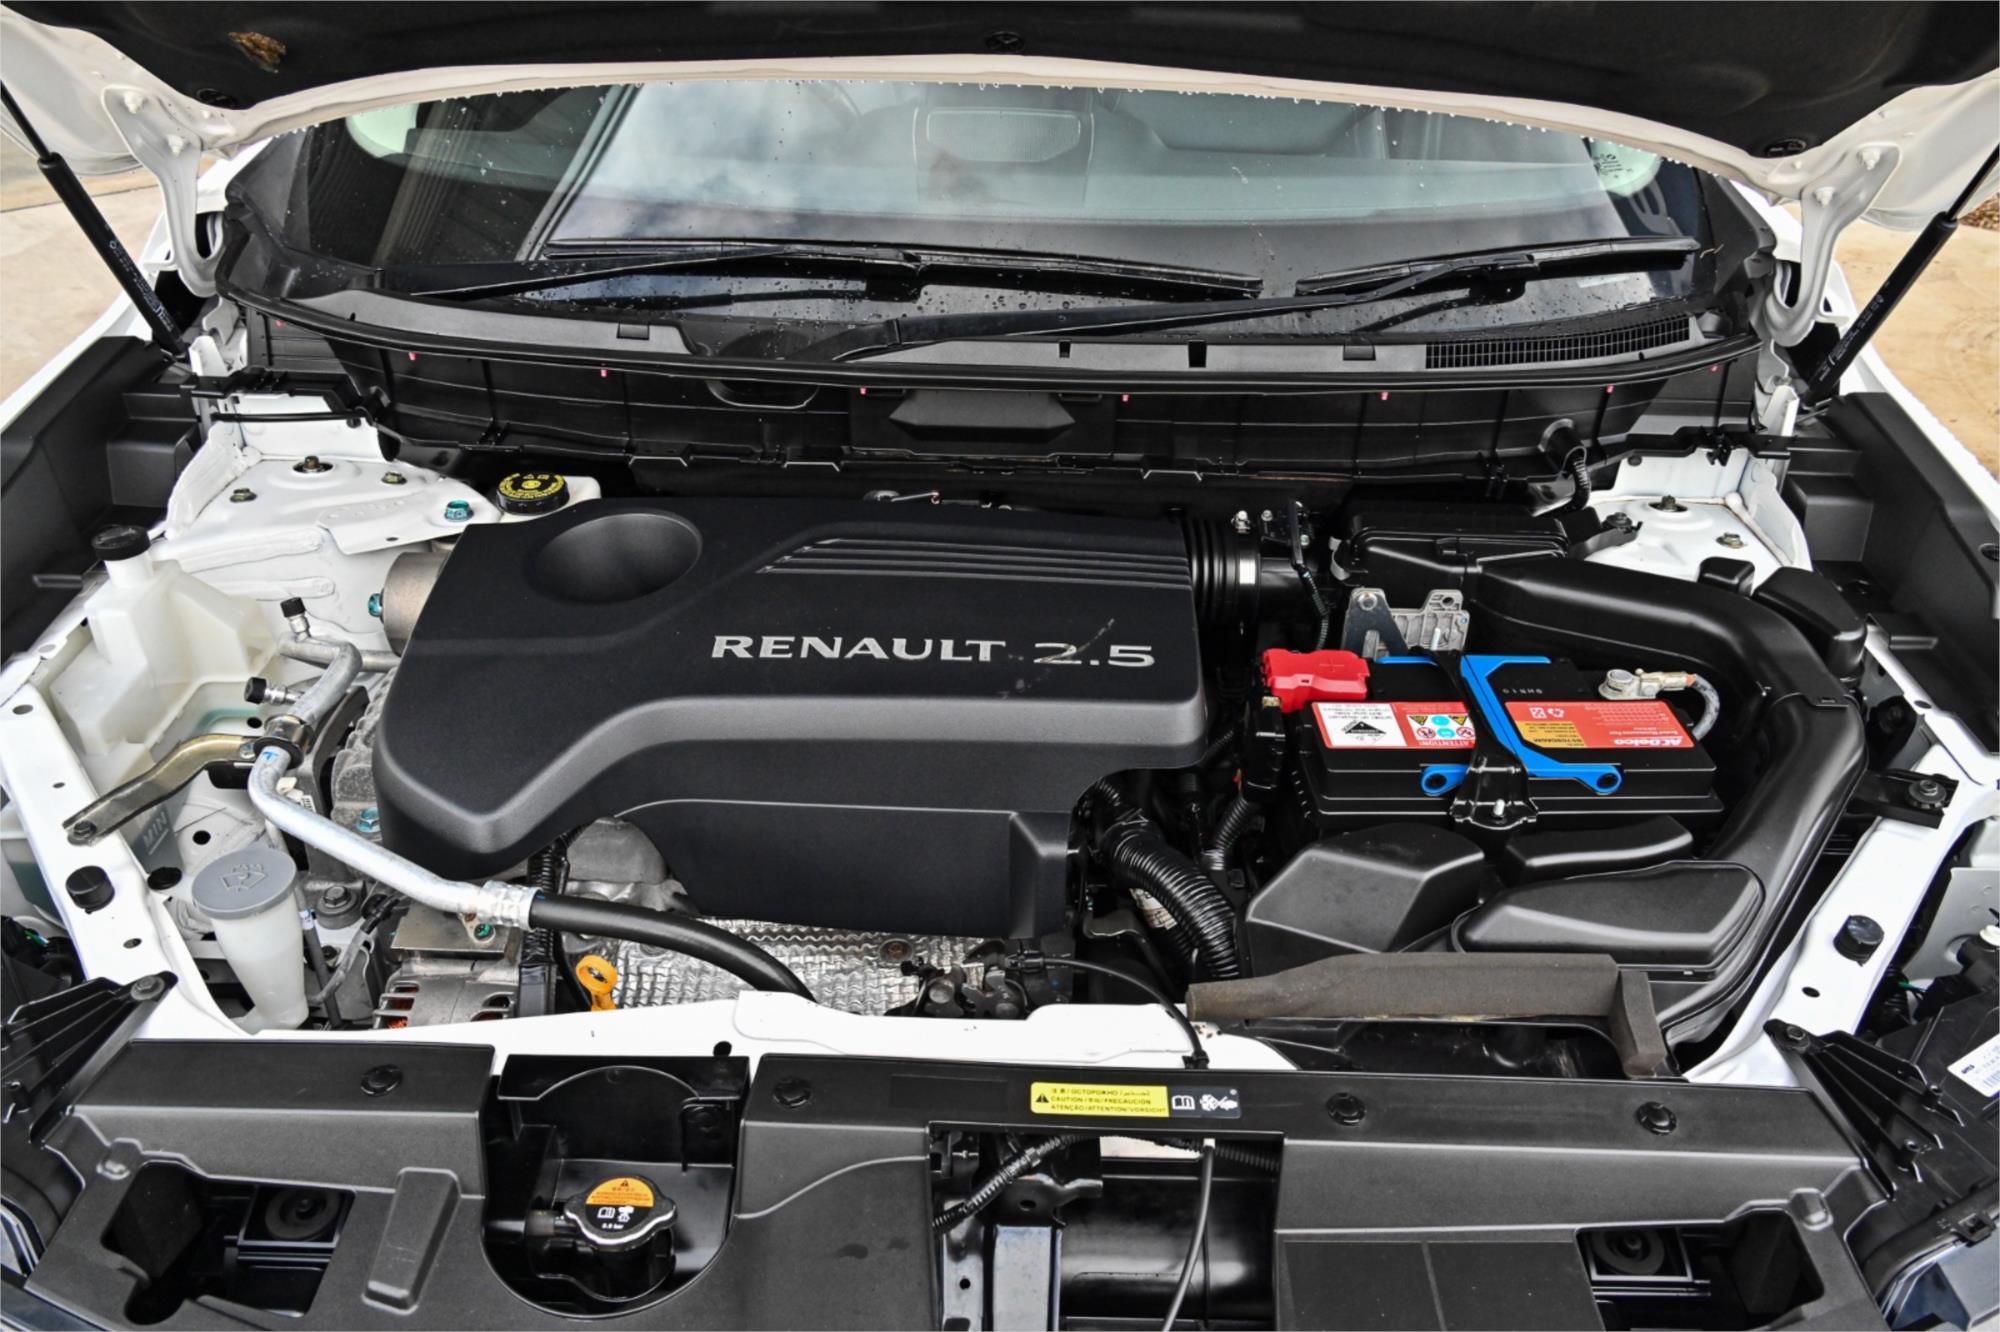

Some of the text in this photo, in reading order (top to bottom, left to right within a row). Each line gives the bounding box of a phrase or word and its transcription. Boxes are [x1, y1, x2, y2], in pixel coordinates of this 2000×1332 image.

[711, 636, 1156, 668] RENAULT 2.5
[1613, 738, 1682, 747] ACDelco
